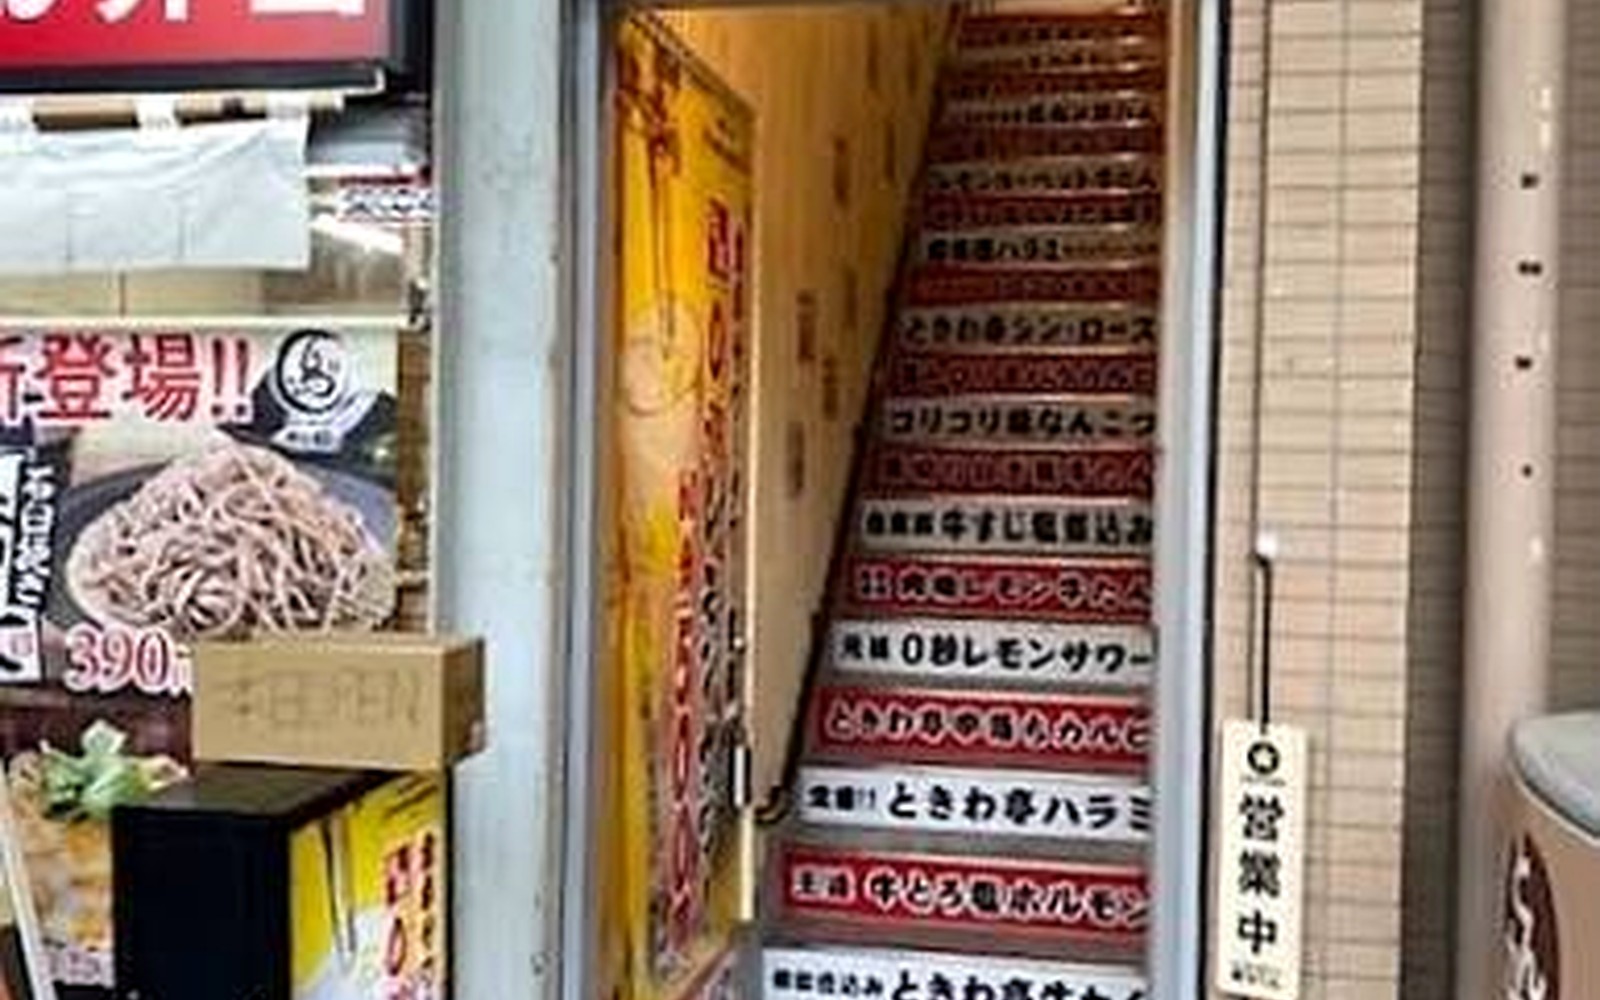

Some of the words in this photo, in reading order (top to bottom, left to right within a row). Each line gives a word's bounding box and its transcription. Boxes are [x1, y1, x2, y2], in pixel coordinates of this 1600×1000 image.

[890, 782, 1151, 830] ときわ亭ハラミ
[1236, 793, 1285, 955] 営業中
[893, 969, 1147, 1000] ときわ亭牛
